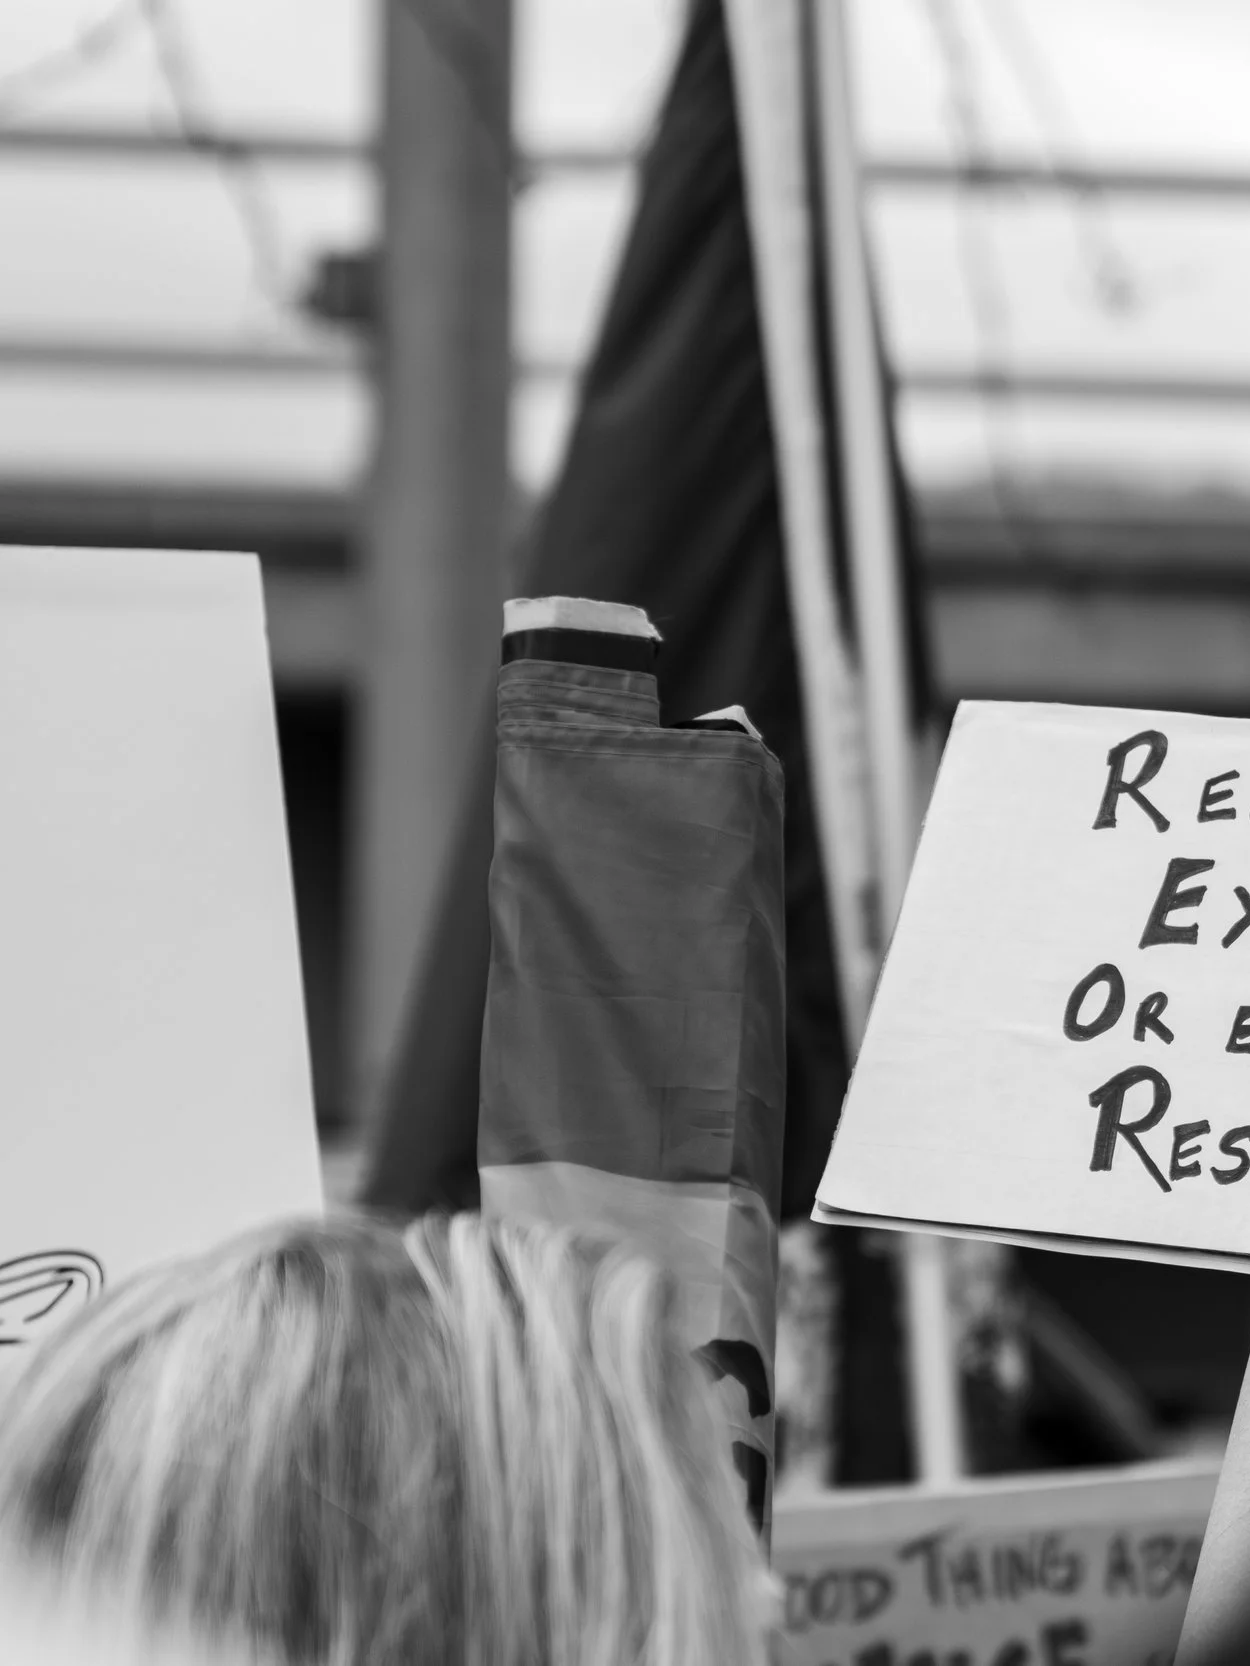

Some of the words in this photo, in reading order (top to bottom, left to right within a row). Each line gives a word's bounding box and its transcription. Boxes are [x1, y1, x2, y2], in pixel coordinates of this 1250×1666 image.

[1063, 963, 1175, 1045] OR
[784, 1567, 894, 1633] OOD
[896, 1521, 1085, 1606] THING
